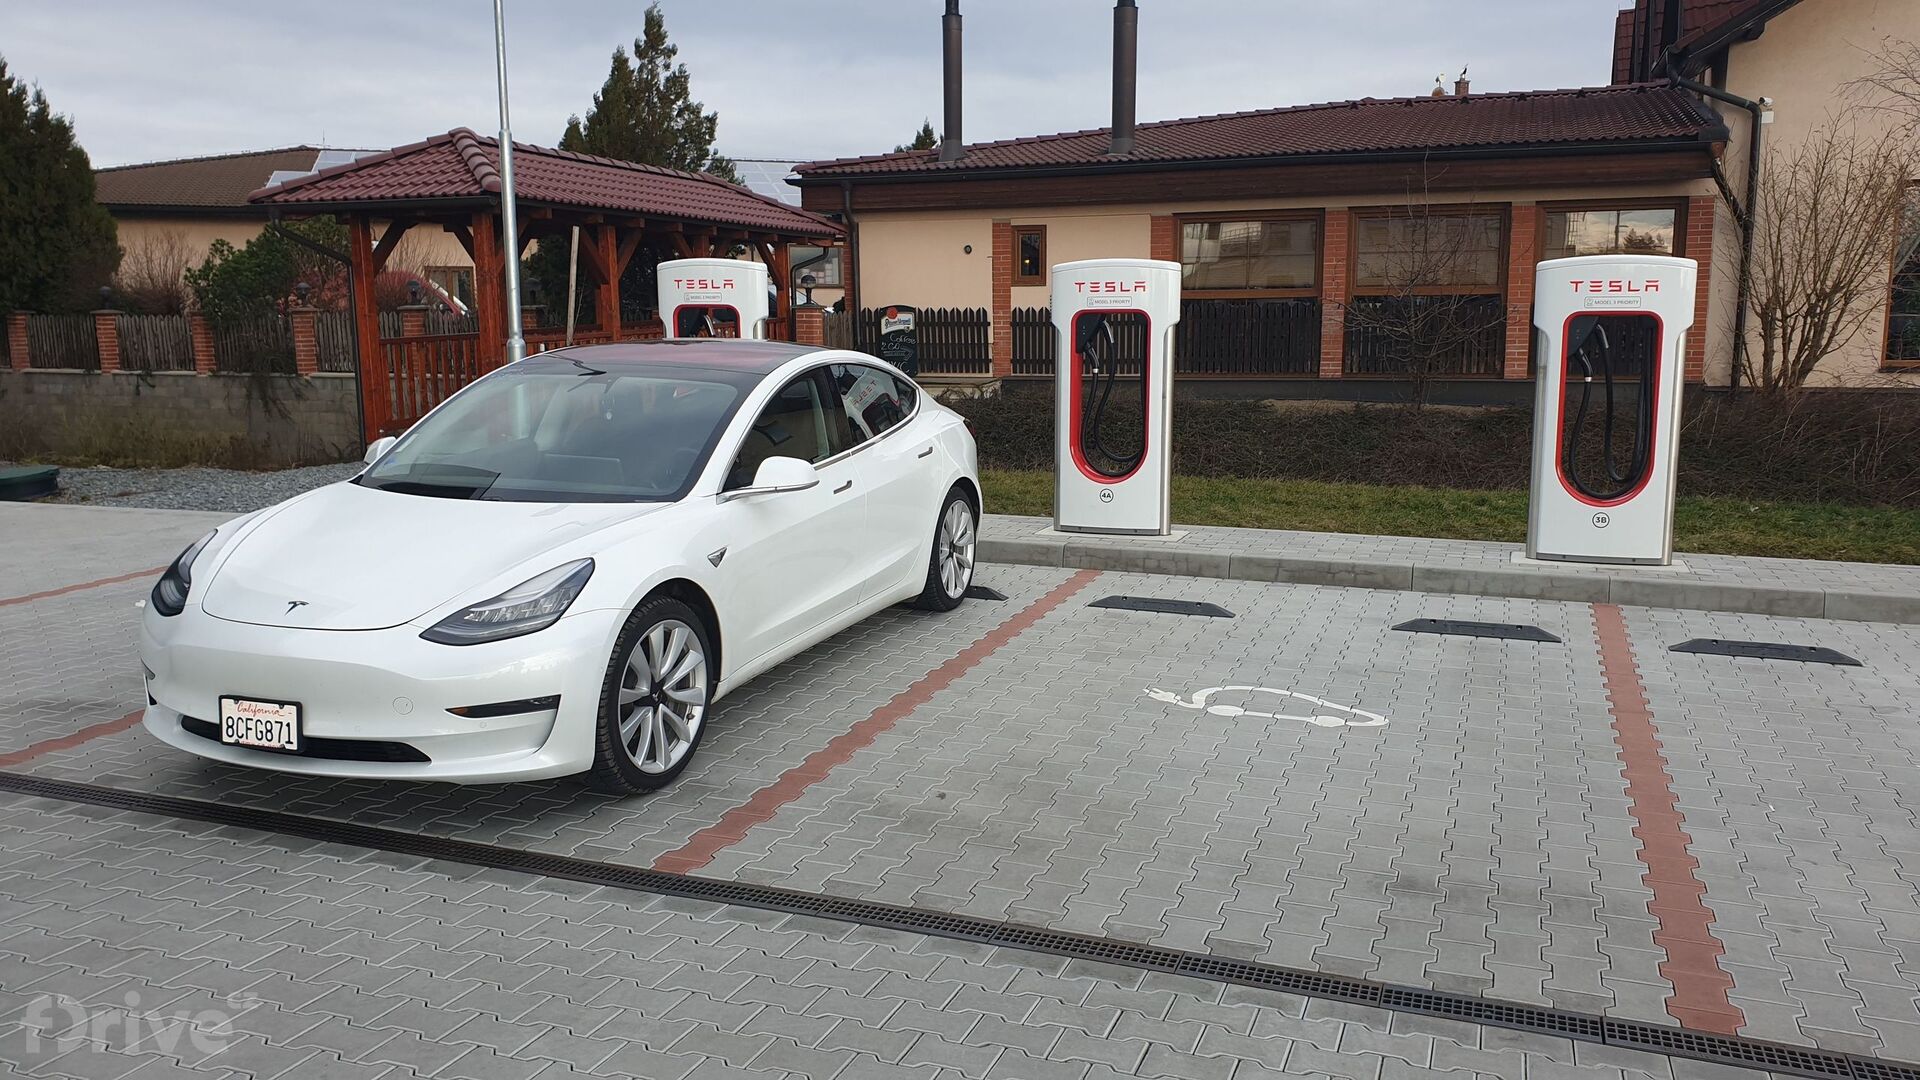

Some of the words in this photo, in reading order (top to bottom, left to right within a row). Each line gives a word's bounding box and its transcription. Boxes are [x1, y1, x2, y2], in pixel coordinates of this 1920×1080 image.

[674, 279, 734, 289] TESLA
[1074, 281, 1146, 292] TESLA
[1570, 280, 1660, 292] TESLA
[1595, 516, 1607, 524] 3B
[237, 702, 285, 717] California
[225, 716, 294, 745] 8CFG871
